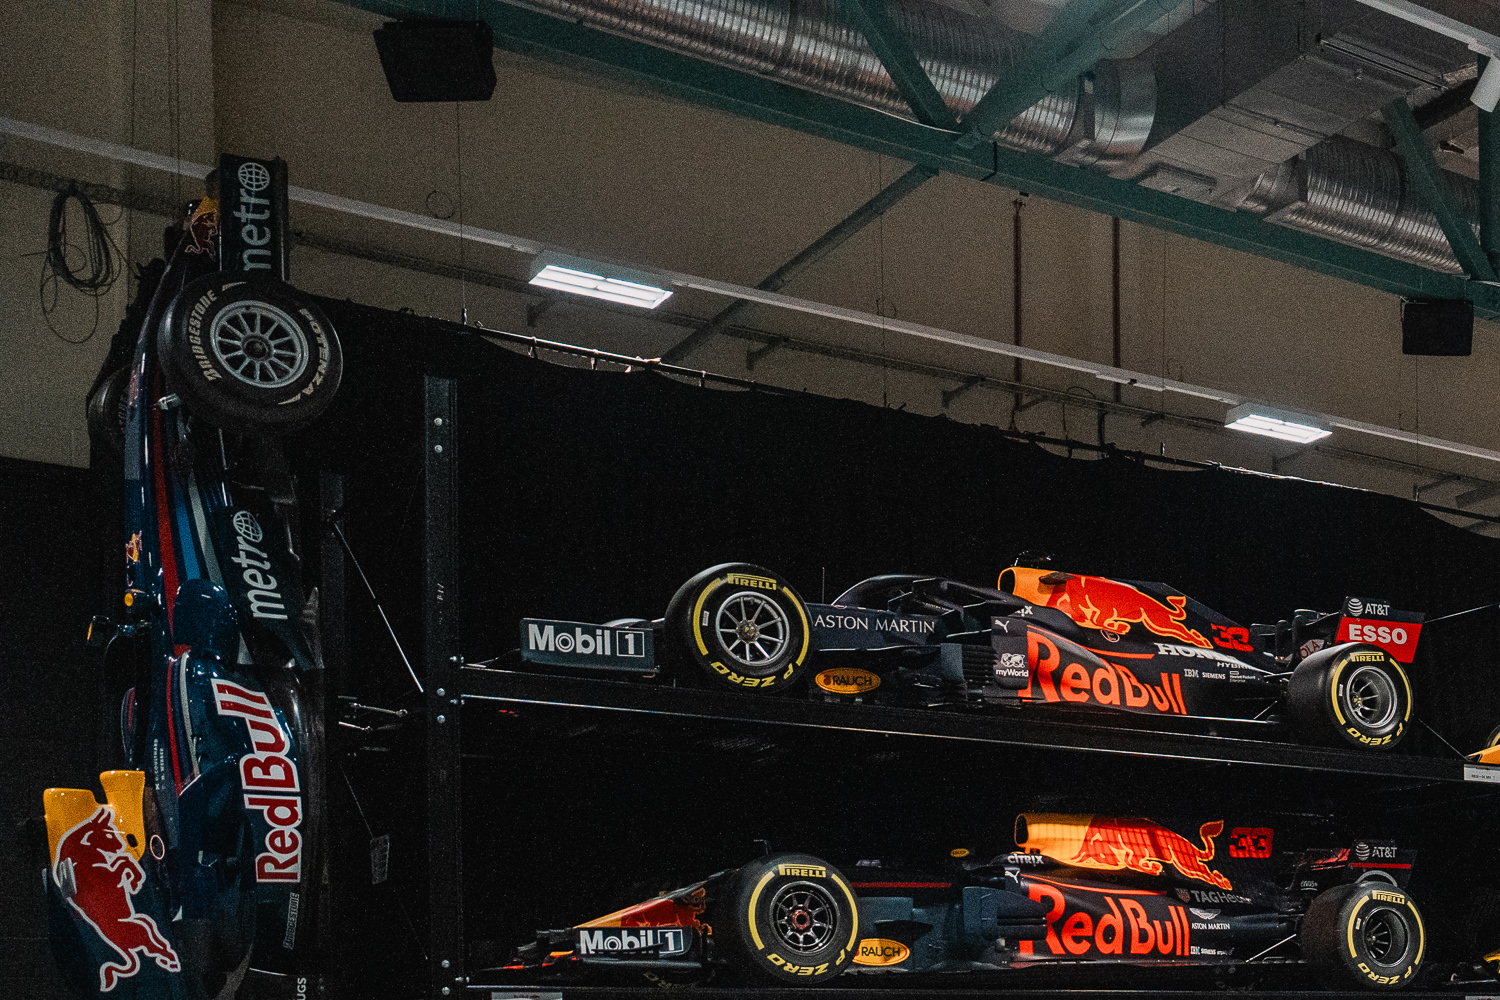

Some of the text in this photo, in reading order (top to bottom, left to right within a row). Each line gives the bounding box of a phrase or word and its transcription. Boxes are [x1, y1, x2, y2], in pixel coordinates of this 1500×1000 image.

[187, 288, 220, 383] BRIDGESTONE
[299, 307, 333, 398] POTENZA
[726, 572, 777, 590] PIRELLI
[1364, 602, 1391, 617] AT&T
[814, 614, 936, 634] ASTON MARTIN
[528, 623, 611, 656] Mobil
[1348, 622, 1408, 645] ESSO
[1350, 651, 1385, 662] PIRELLI
[832, 674, 873, 688] RAUCH
[995, 669, 1030, 679] myWorld
[1229, 826, 1275, 859] 33
[1371, 845, 1398, 859] AT&T
[777, 863, 828, 879] PIRELLI
[1372, 889, 1405, 905] PIRELLI
[1208, 922, 1231, 931] MARTIN
[578, 929, 655, 956] Mobil
[861, 944, 901, 959] RAUCH
